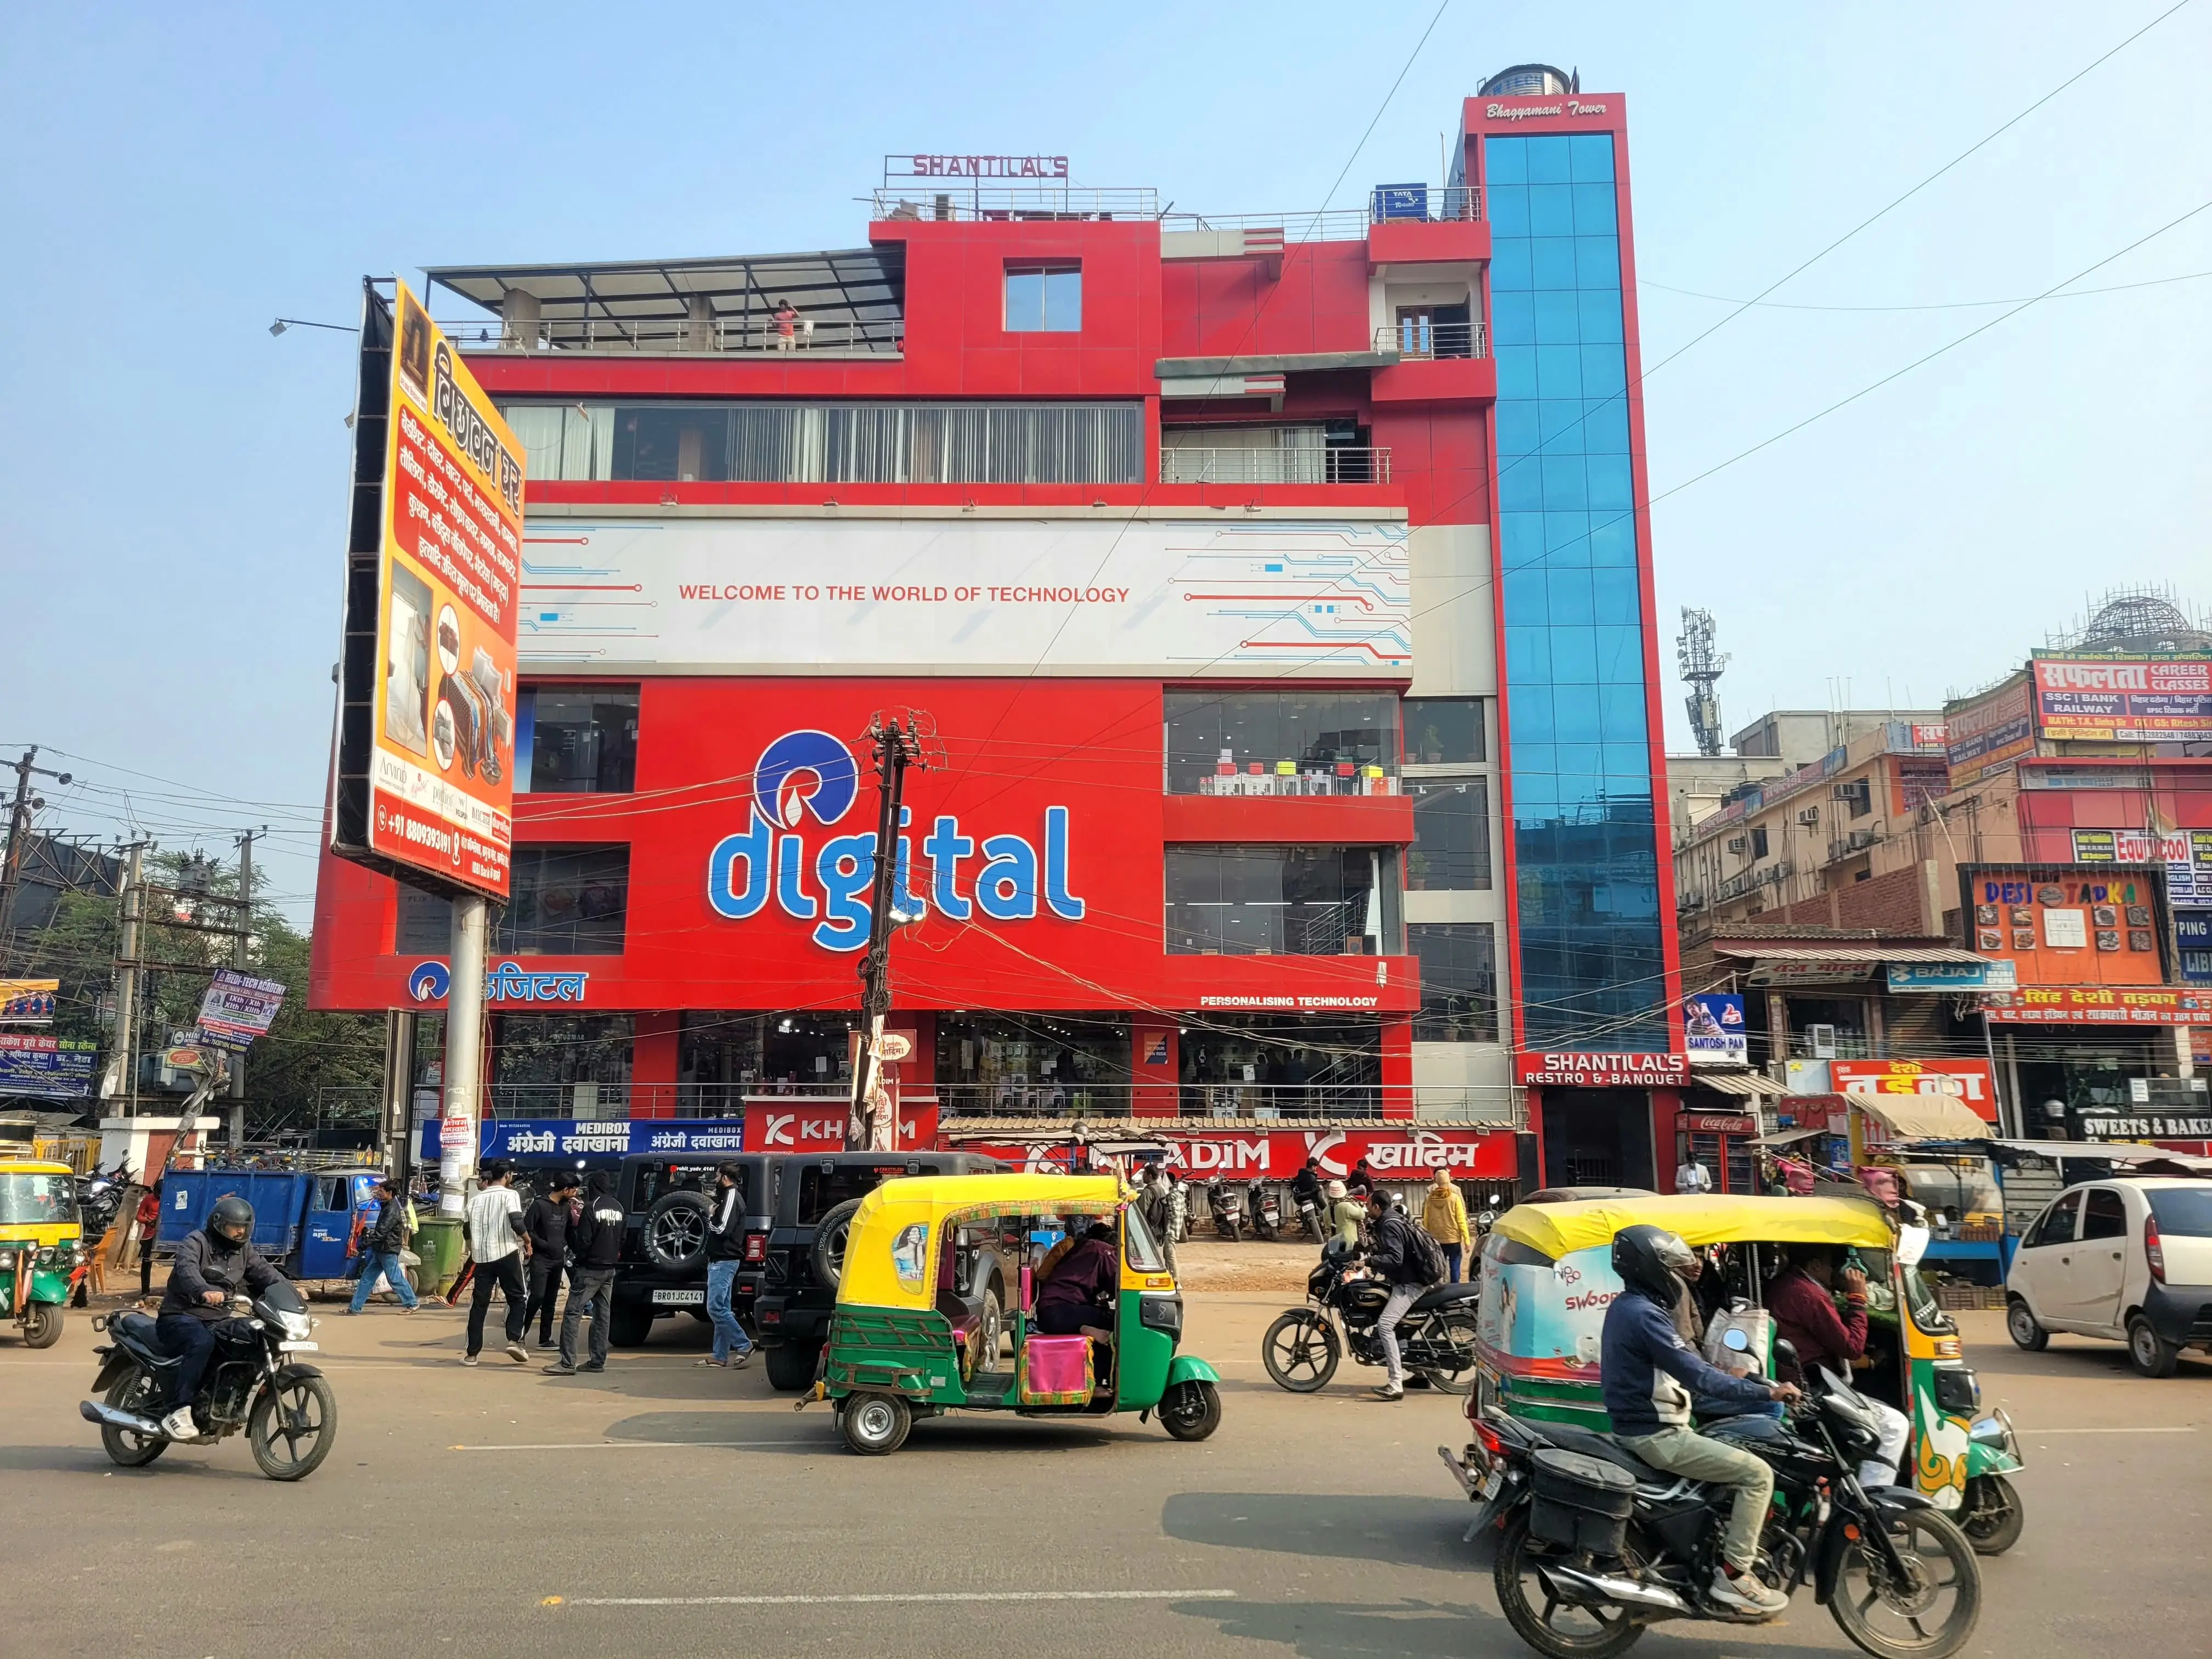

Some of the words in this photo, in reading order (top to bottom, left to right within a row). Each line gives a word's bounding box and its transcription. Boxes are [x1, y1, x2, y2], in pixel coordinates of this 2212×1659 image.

[1487, 103, 1561, 121] Bhagyamani
[1568, 101, 1606, 116] Tower
[913, 154, 1068, 177] SHANTILAL'S
[433, 339, 499, 488] बिछावन
[499, 441, 522, 517] घर
[679, 584, 786, 601] WELCOME
[792, 585, 820, 601] TO
[826, 585, 866, 601] THE
[872, 585, 948, 602] WORLD
[954, 586, 981, 602] OF
[988, 586, 1130, 603] TECHNOLOGY
[2040, 663, 2148, 689] सफलता
[2151, 664, 2208, 676] CAREER
[2152, 680, 2210, 691] CLASSES
[2045, 692, 2072, 701] SSC
[2081, 693, 2119, 703] BANK
[2054, 704, 2113, 714] RAILWAY
[2171, 719, 2199, 727] Ritesh
[388, 813, 404, 837] +91
[707, 800, 1086, 952] digital
[1985, 882, 2032, 904] DESI
[2065, 881, 2136, 904] TADKA
[1915, 967, 1980, 978] BAJAJ
[224, 973, 258, 990] MEDI-TECH
[257, 980, 287, 995] ACADEMY
[229, 994, 244, 1003] IXth
[1200, 996, 1294, 1006] PERSONALISING
[1298, 997, 1378, 1007] TECHNOLOGY
[2023, 989, 2062, 1004] सिंह
[2069, 989, 2115, 1004] देशी
[2120, 992, 2177, 1007] तड़का
[1688, 1037, 1726, 1049] SANTOSH
[1729, 1037, 1744, 1049] PAN
[1544, 1054, 1684, 1072] SHANTILAL'S
[1888, 1061, 1924, 1074] देशी
[1526, 1072, 1585, 1084] RESTRO
[1593, 1073, 1603, 1083] &
[1611, 1073, 1685, 1085] BANQUET
[576, 1122, 631, 1135] MEDIBOX
[801, 1120, 916, 1139] KHM
[2084, 1118, 2149, 1136] SWEETS
[2152, 1117, 2164, 1135] &
[507, 1130, 556, 1154] अंग्रेजी
[562, 1135, 630, 1155] दवाखाना
[651, 1131, 687, 1149] अंग्रेजी
[691, 1135, 741, 1150] दवाखाना
[1364, 1131, 1480, 1170] खादिम
[657, 1291, 702, 1301] BR01JC4141
